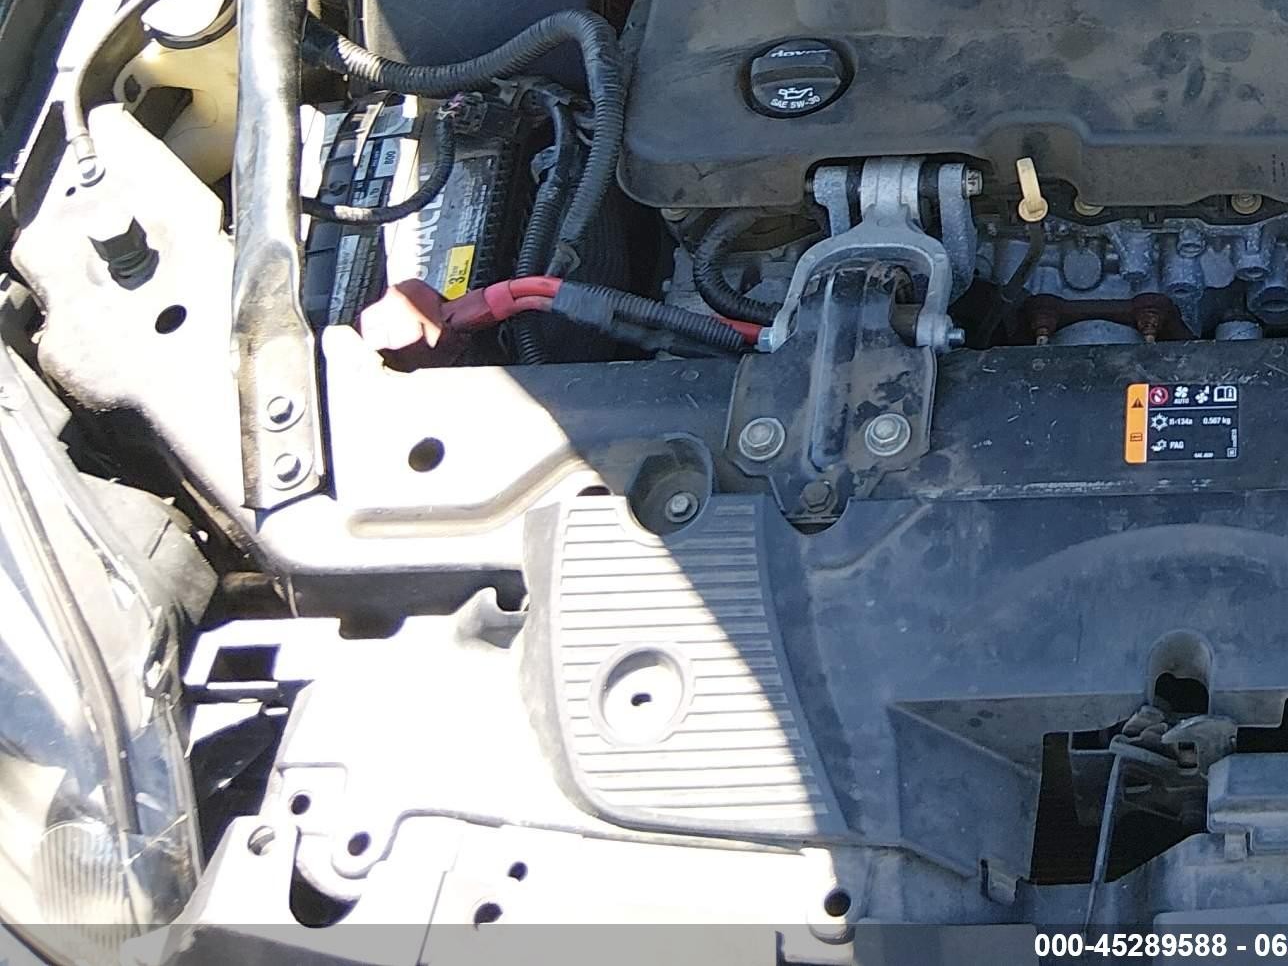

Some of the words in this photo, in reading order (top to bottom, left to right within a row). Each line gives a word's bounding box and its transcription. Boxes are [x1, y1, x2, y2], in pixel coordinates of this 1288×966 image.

[770, 98, 788, 109] SAE
[790, 95, 821, 109] 5W-30
[1222, 417, 1232, 426] kg
[1169, 441, 1185, 449] PAG
